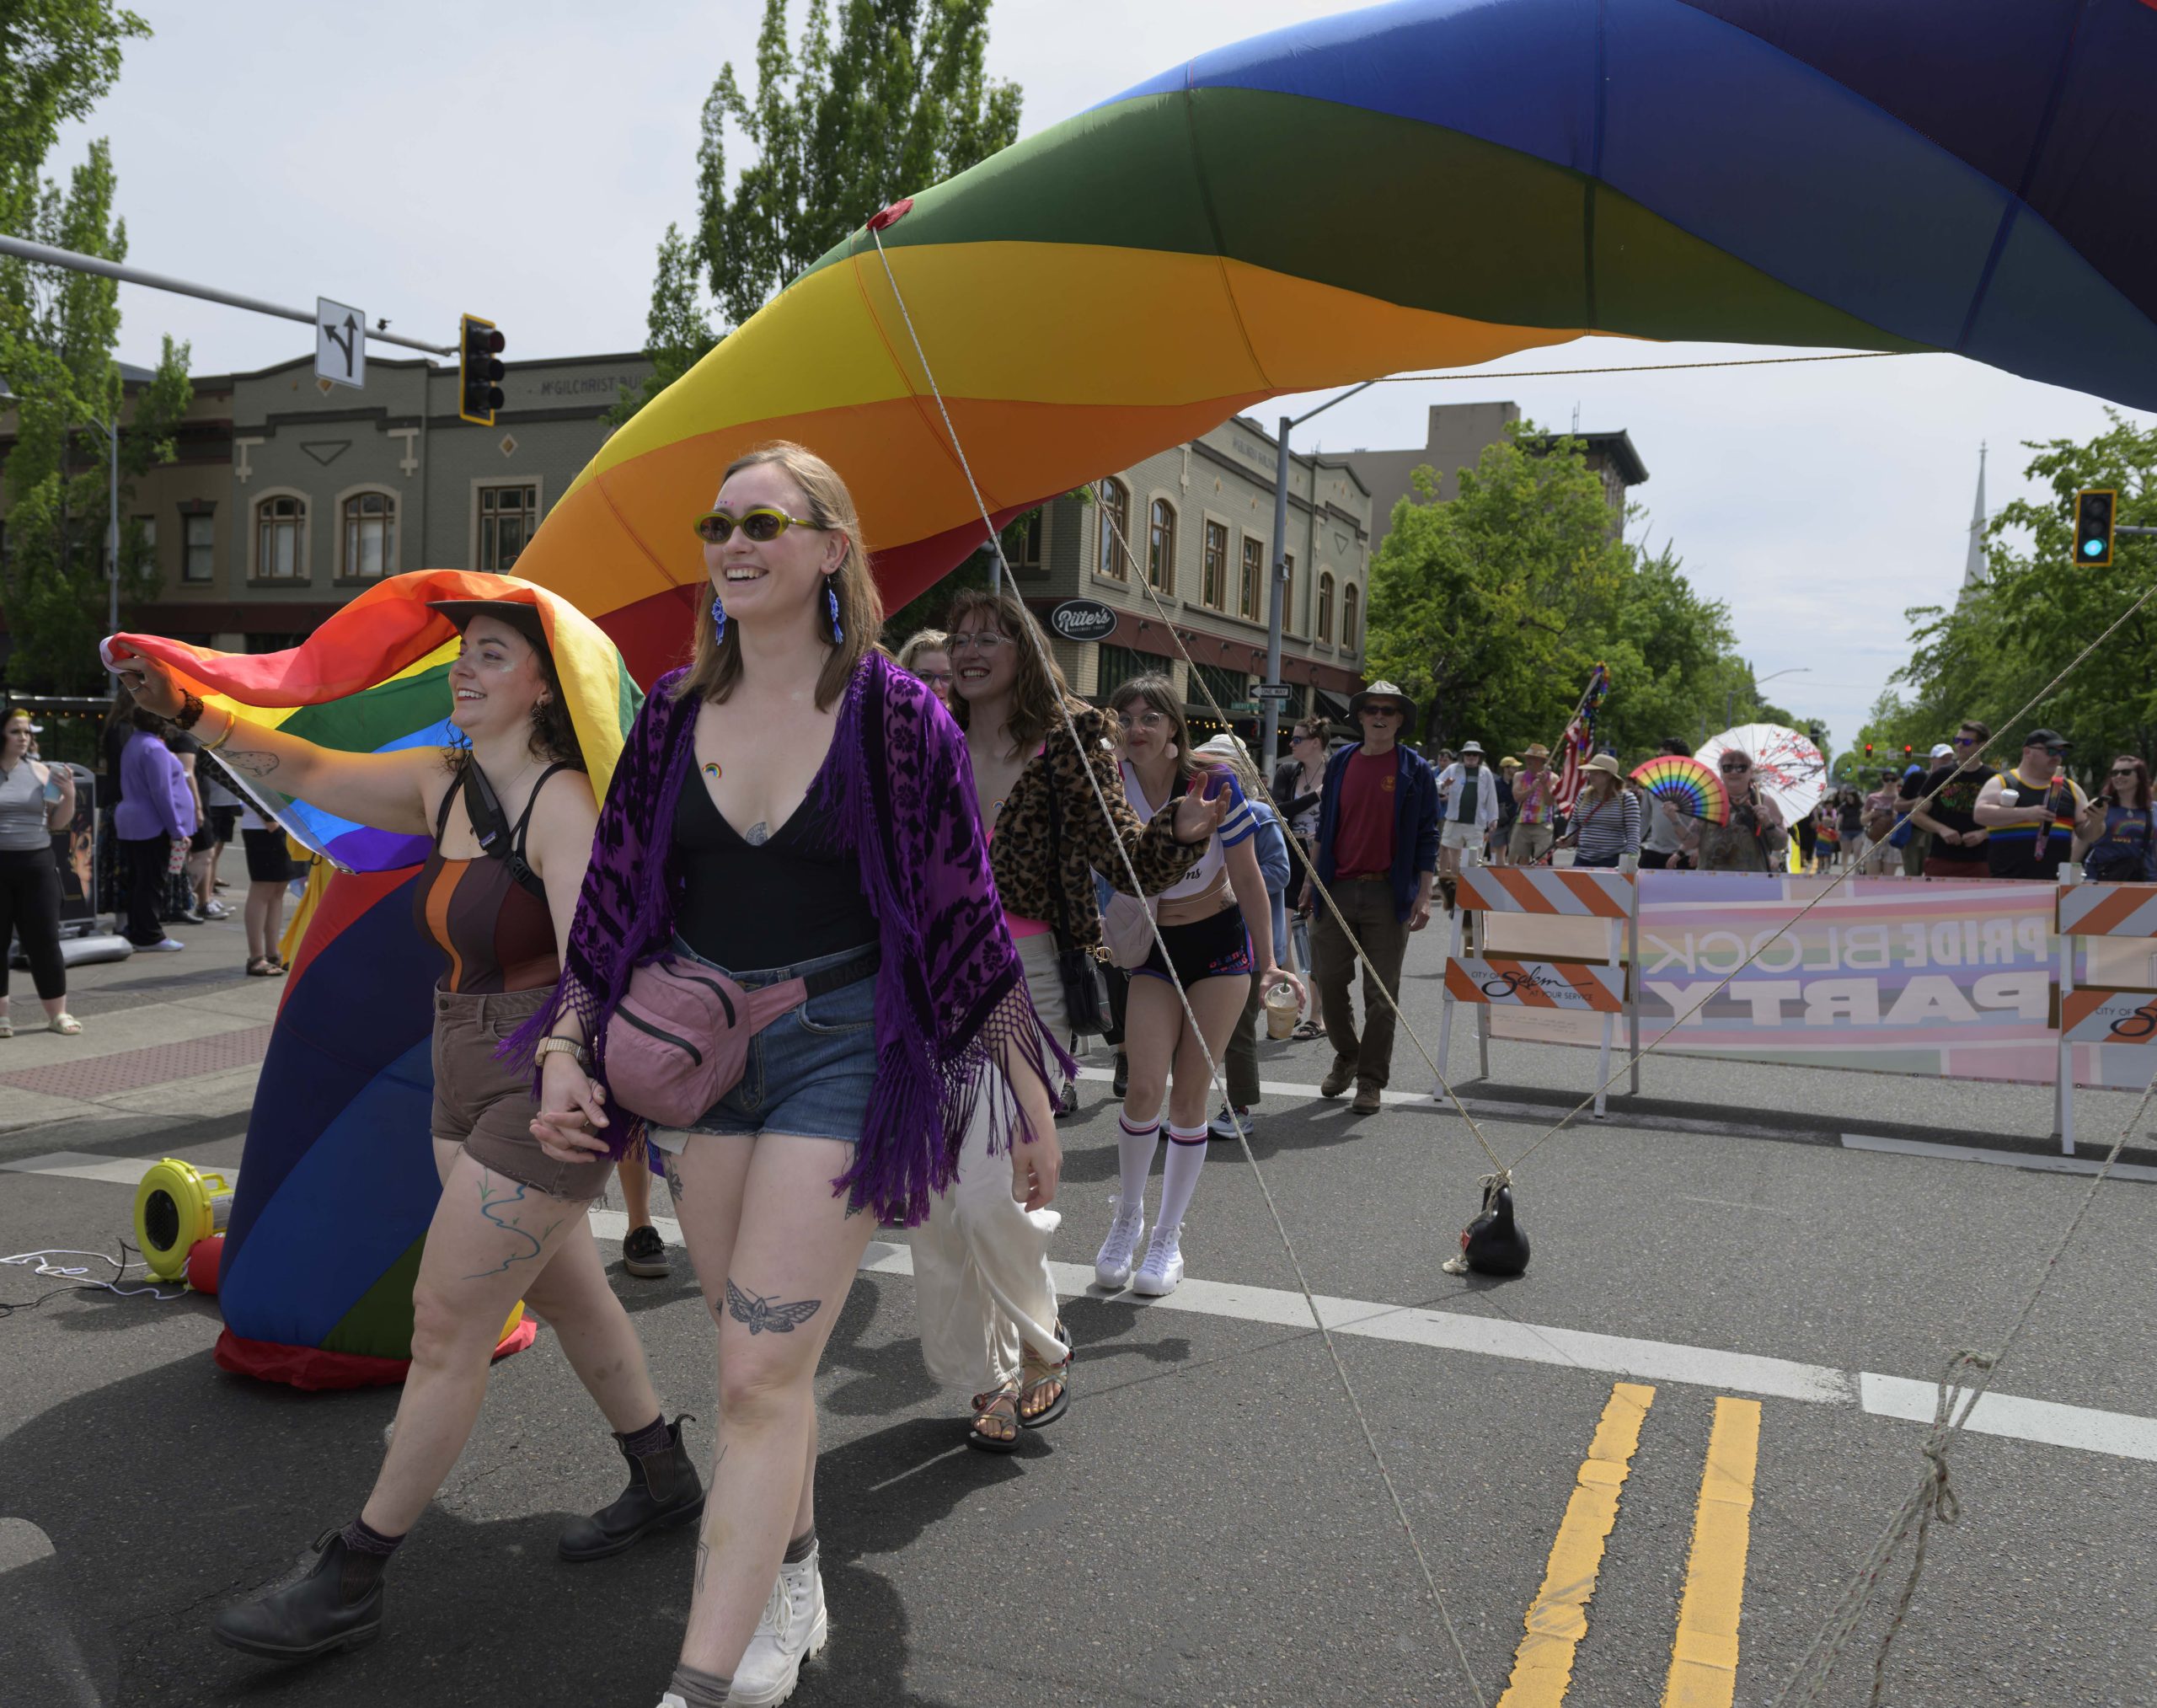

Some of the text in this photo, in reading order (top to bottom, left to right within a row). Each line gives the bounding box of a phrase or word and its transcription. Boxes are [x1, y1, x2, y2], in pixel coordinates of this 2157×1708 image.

[1058, 608, 1111, 632] Ritter's
[1491, 972, 1501, 980] OF
[1481, 966, 1593, 998] Salem
[1541, 991, 1562, 999] YOUR
[1564, 992, 1593, 1002] SERVICE
[2095, 1007, 2133, 1016] CITY OF
